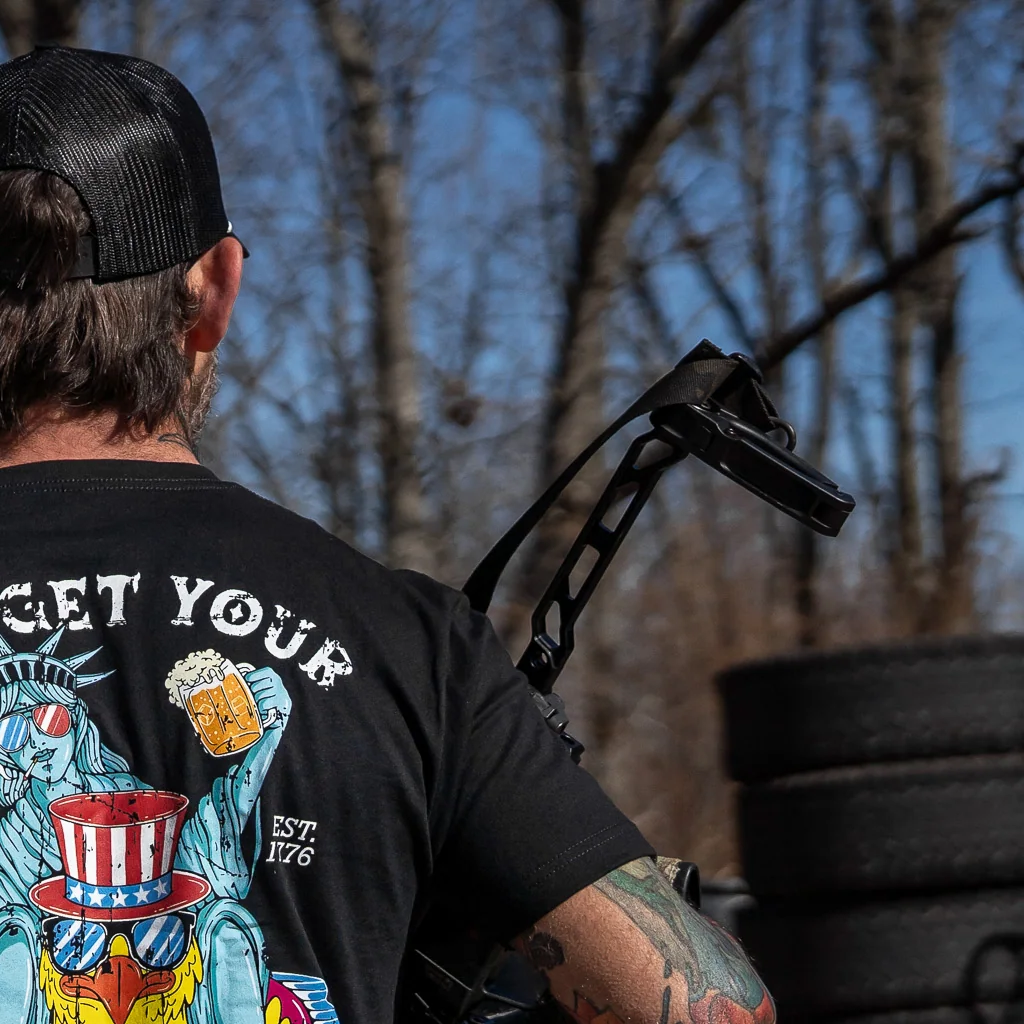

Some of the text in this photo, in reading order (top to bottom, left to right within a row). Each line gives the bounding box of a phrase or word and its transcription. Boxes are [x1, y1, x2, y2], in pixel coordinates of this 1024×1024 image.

[170, 575, 353, 690] YOUR
[272, 815, 317, 843] EST.
[265, 841, 315, 866] 1776
